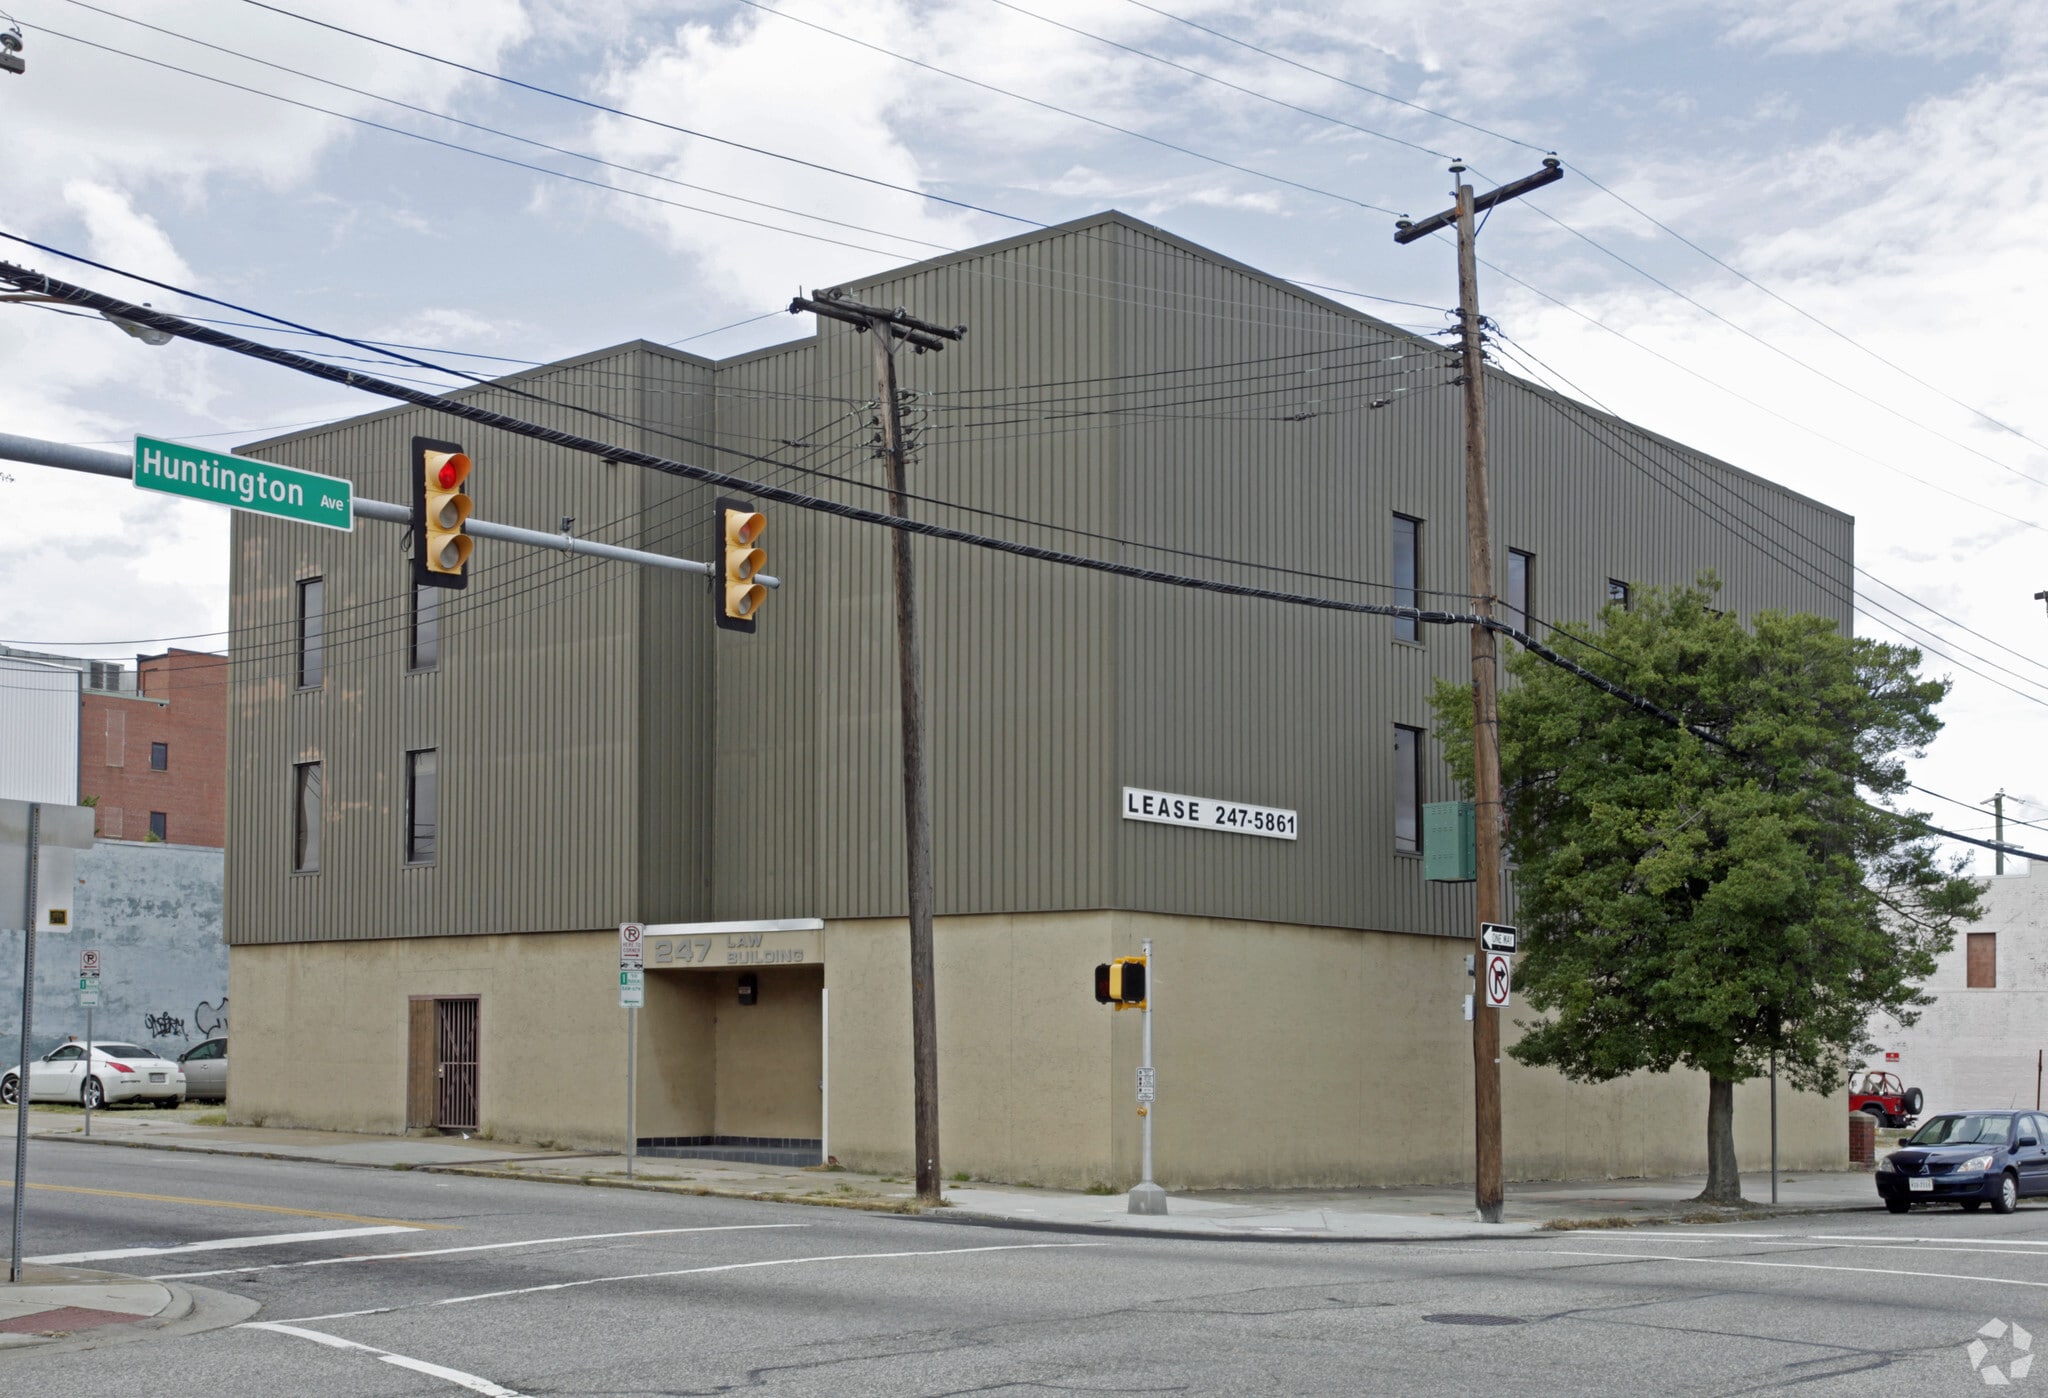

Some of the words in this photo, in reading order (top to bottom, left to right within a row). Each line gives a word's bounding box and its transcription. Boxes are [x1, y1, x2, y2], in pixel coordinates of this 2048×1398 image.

[143, 447, 303, 506] Huntington
[320, 495, 344, 511] Ave
[1128, 793, 1200, 821] LEASE
[1215, 806, 1295, 834] 247-5861
[727, 934, 763, 949] LAW
[1492, 932, 1502, 944] ONE
[1503, 934, 1514, 945] WAY
[655, 938, 712, 963] 247
[727, 949, 804, 965] BUILDING
